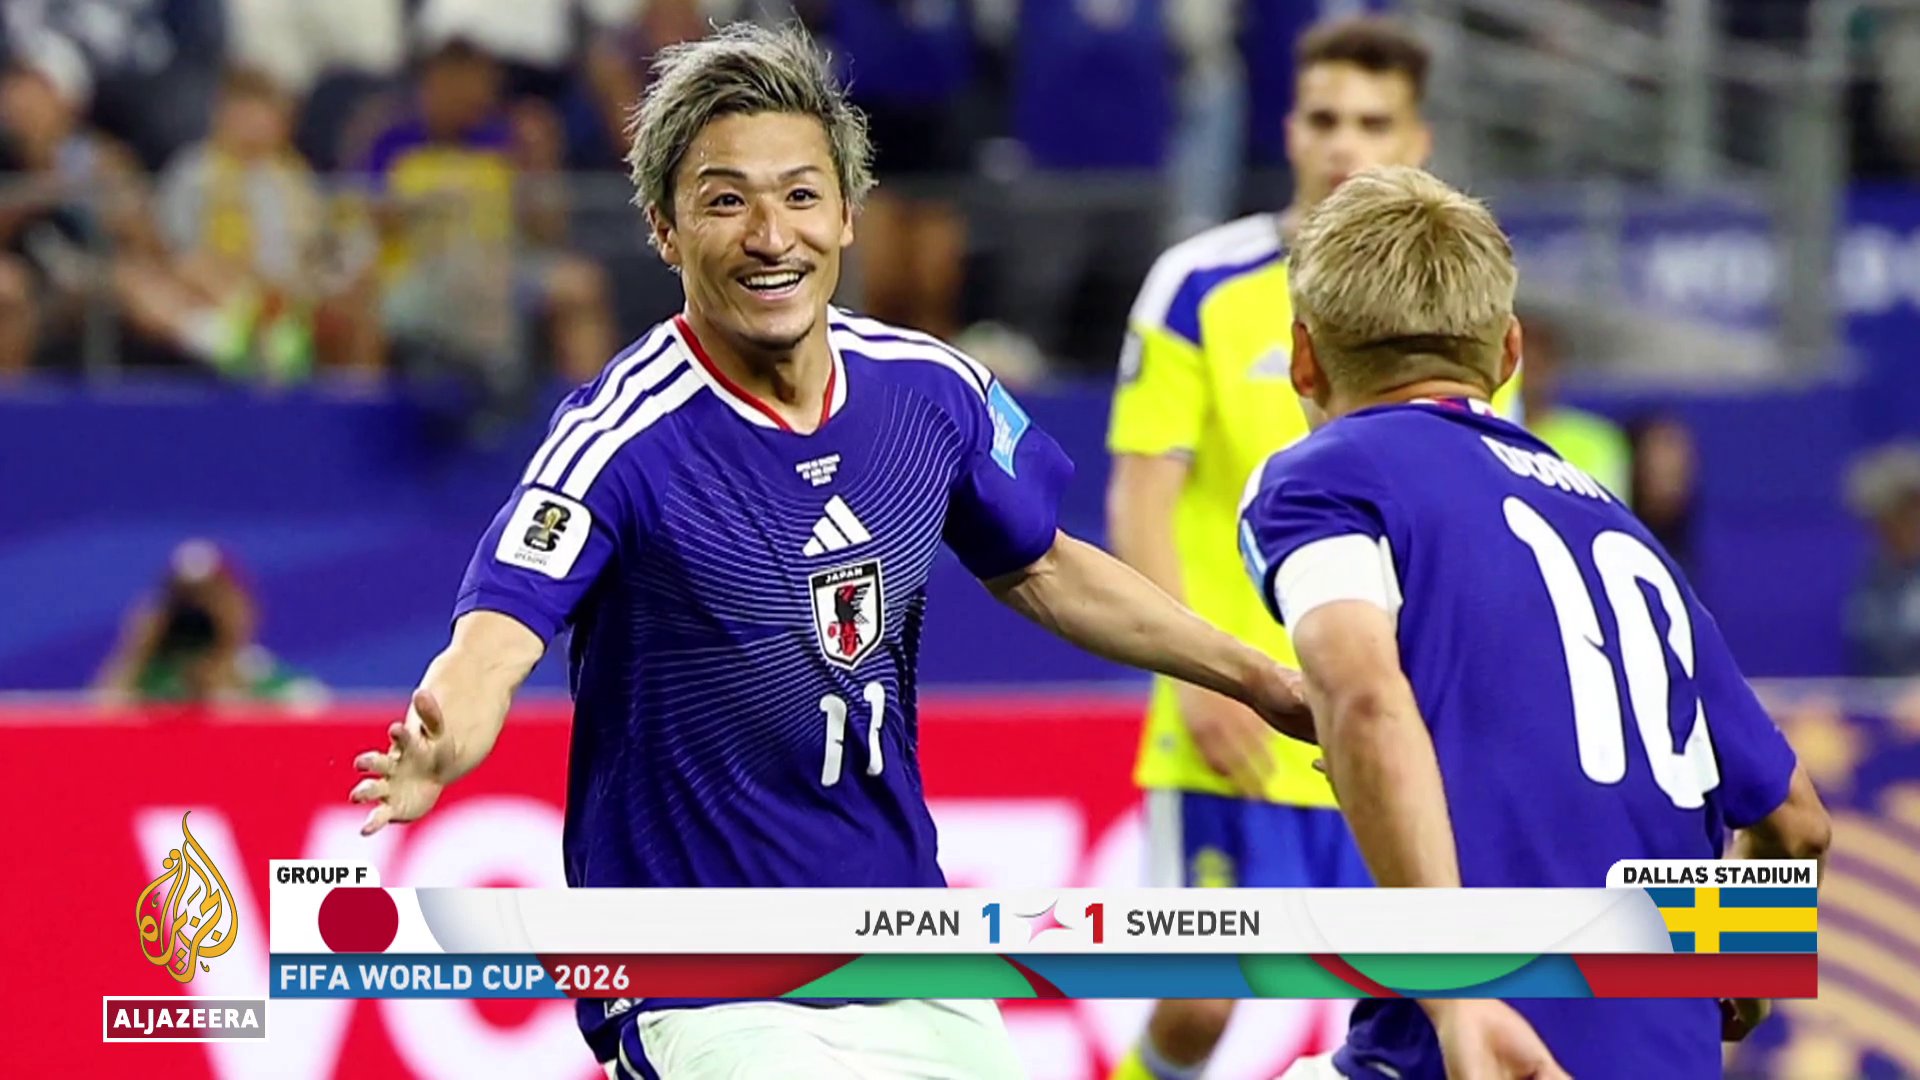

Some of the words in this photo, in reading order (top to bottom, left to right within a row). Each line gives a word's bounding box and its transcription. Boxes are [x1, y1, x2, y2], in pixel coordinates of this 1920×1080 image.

[825, 567, 863, 584] JAPAN
[1502, 496, 1721, 810] 10
[819, 682, 886, 787] 11
